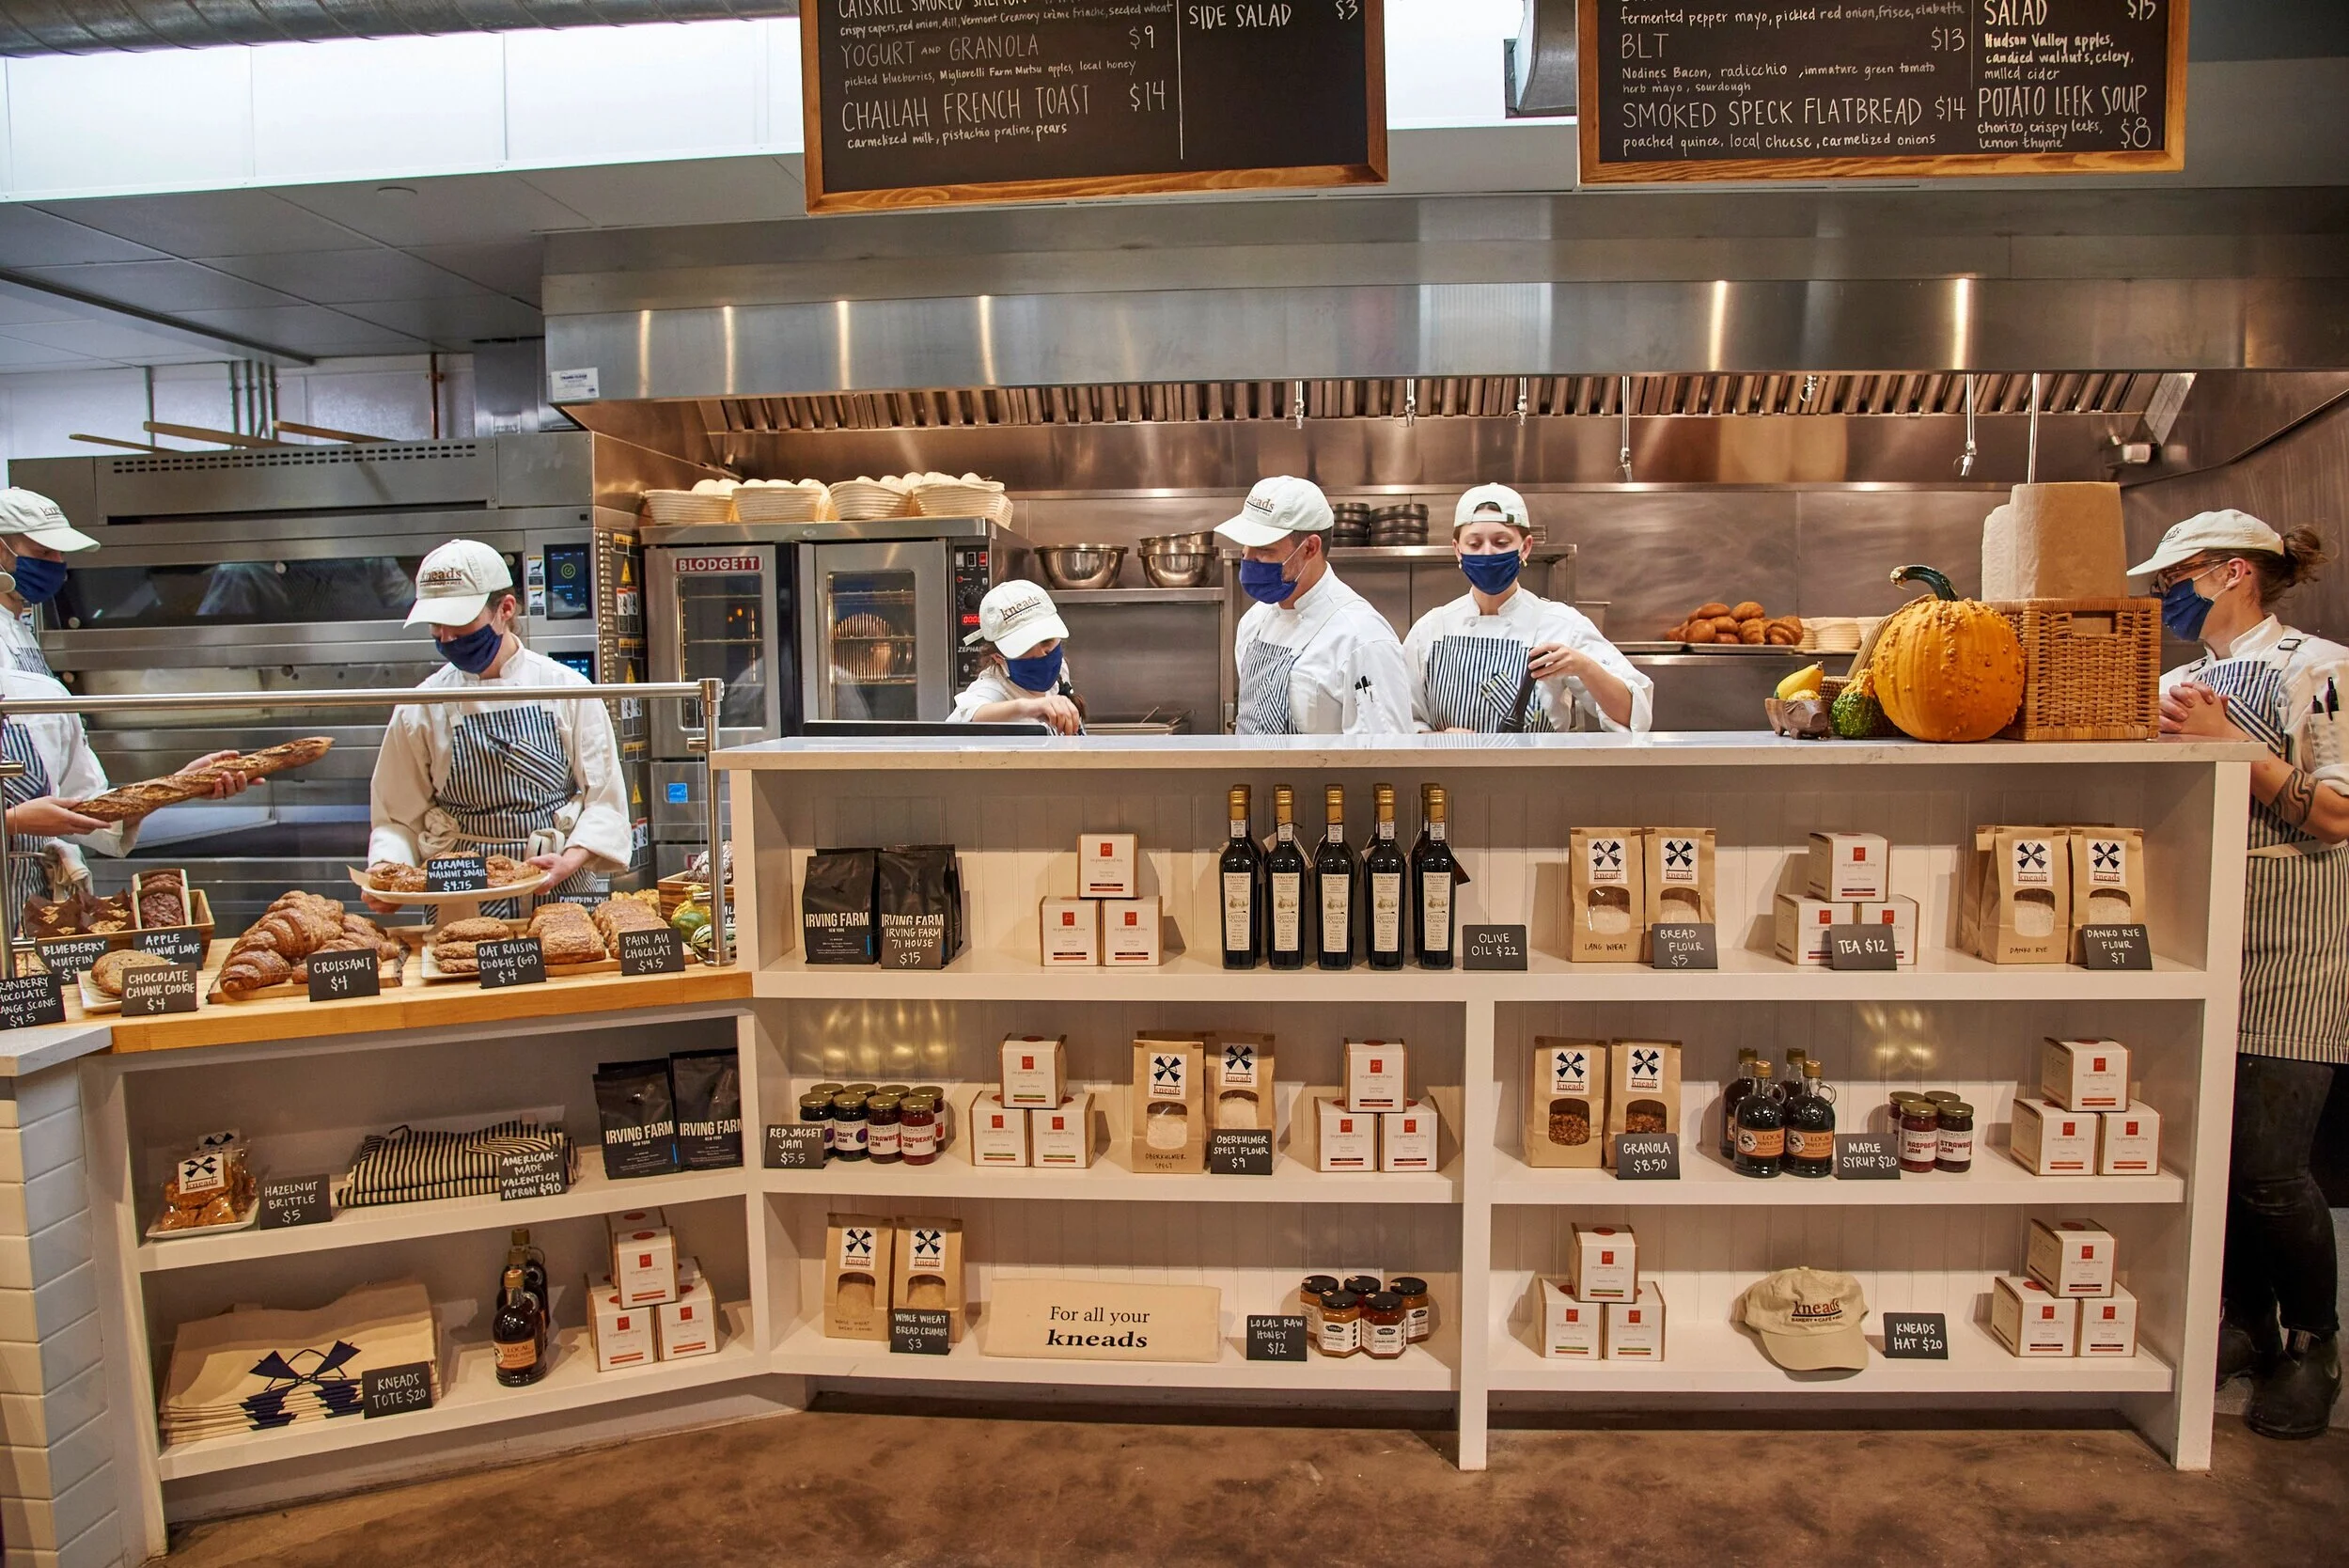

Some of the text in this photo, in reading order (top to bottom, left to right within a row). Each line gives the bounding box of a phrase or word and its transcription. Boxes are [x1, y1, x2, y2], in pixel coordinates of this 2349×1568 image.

[1189, 3, 1292, 30] SIDE SALAD
[1621, 6, 1728, 29] fermented pepper
[1983, 0, 2047, 26] SALAD
[1129, 24, 1154, 50] $9
[1621, 26, 1965, 59] BLT $13
[1984, 33, 2068, 53] Hudson Valley
[840, 34, 1039, 69] YOGURT AND GRANOLA
[1985, 52, 2033, 64] candied
[844, 60, 1135, 94] pickled Farm Mutsu local honey
[1720, 62, 1935, 81] radicchio green tomato
[1984, 66, 2060, 81] mulled cider
[1129, 80, 1166, 111] $14
[1696, 82, 1751, 97] sourdough
[842, 85, 1089, 133] CHALLAH FRENCH TOAST
[1979, 85, 2148, 118] POTATO LEEK SOUP
[1622, 96, 1966, 129] SMOKED SPECK FLATBREAD $14
[847, 122, 1068, 149] carmelized pistachio pears
[2120, 117, 2152, 149] $8
[1622, 133, 1935, 157] poached local onions
[1979, 135, 2063, 153] lemon thyme
[679, 557, 756, 572] BLODGETT
[431, 858, 479, 870] CARAMEL
[428, 868, 487, 880] WALNUT SNAIL
[806, 912, 869, 928] IRVING FARM
[145, 933, 180, 946] APPLE
[625, 933, 670, 946] PAIN AU
[885, 927, 941, 939] IRVING FARM
[1479, 933, 1510, 944] OLIVE
[1660, 929, 1697, 939] BREAD
[2087, 928, 2140, 938] DANKO RYE
[42, 940, 106, 956] BLUEBERRY
[179, 943, 200, 955] LOAF
[479, 941, 539, 958] OAT RAISIN
[892, 938, 933, 949] 71 HOUSE
[1668, 942, 1704, 952] FLOUR
[1838, 938, 1888, 955] TEA $12
[2101, 940, 2133, 949] FLOUR
[624, 945, 671, 959] CHOCOLAT
[900, 951, 921, 965] $15
[1471, 945, 1519, 958] OIL $22
[2111, 952, 2126, 964] $7
[51, 954, 93, 968] MUFFIN
[313, 956, 371, 974] CROISSANT
[480, 954, 538, 969] COOKIE (GF)
[637, 957, 664, 973] $4.5
[1671, 954, 1688, 966] $5
[128, 969, 189, 984] CHOCOLATE
[331, 975, 348, 992] $4
[497, 968, 518, 984] $4
[126, 982, 196, 999] CHUNK COOKIE
[27, 996, 56, 1011] SCONE
[147, 997, 166, 1011] $4
[9, 1012, 36, 1027] $4.5
[605, 1120, 674, 1145] IRVING FARM
[680, 1121, 714, 1137] IRVING
[770, 1127, 822, 1138] RED JACKET
[778, 1139, 803, 1149] JAM
[1216, 1135, 1269, 1144] OBERKULMER
[1214, 1146, 1269, 1155] SPELT FLOUR
[1623, 1141, 1671, 1155] GRANOLA
[1848, 1142, 1881, 1154] MAPLE
[780, 1152, 806, 1166] $5.5
[1231, 1157, 1246, 1168] $9
[1633, 1159, 1668, 1173] $8.50
[1842, 1155, 1897, 1168] SYRUP $20
[514, 1163, 543, 1176] MADE
[501, 1171, 560, 1187] VALENTICH
[264, 1181, 318, 1197] HAZELNUT
[504, 1183, 562, 1200] APRON $90
[269, 1194, 316, 1210] BRITTLE
[282, 1209, 301, 1224] $5
[1793, 1298, 1840, 1314] kneads
[895, 1313, 947, 1324] WHOLE WHEAT
[1050, 1306, 1150, 1325] For all your
[1250, 1318, 1304, 1328] LOCAL RAW
[895, 1325, 947, 1336] BREAD CRUMBS
[1257, 1329, 1287, 1340] HONEY
[1895, 1323, 1935, 1335] KNEADS
[908, 1338, 923, 1351] $3
[1045, 1328, 1149, 1348] kneads
[1893, 1337, 1943, 1352] HAT $20
[1267, 1341, 1288, 1355] $12
[377, 1372, 419, 1391] KNEADS
[372, 1388, 427, 1408] TOTE $20
